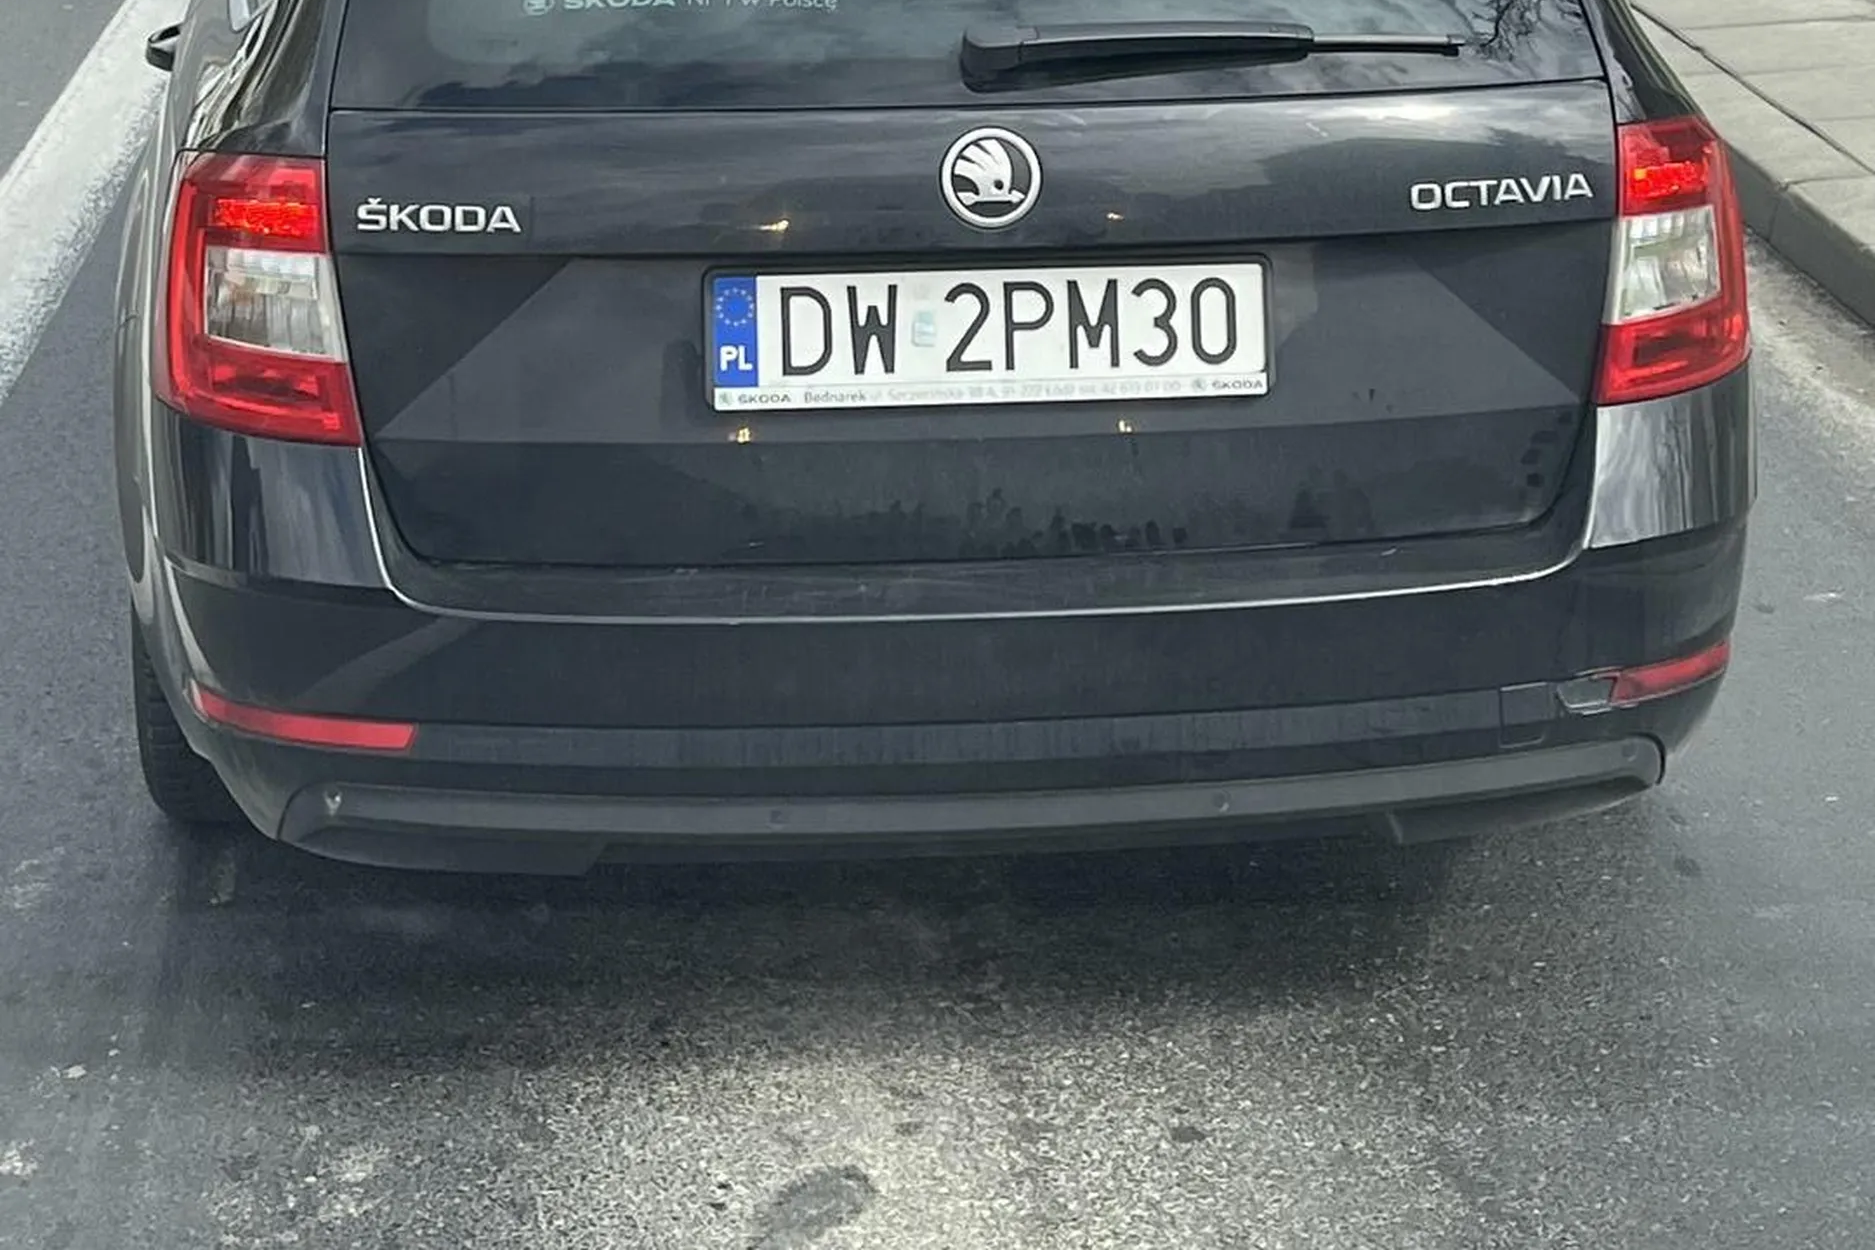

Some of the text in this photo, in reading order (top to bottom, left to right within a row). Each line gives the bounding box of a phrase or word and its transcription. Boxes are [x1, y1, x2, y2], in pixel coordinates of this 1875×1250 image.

[1410, 172, 1594, 211] OCTAVIA
[356, 197, 522, 233] ŠKODA
[780, 276, 1239, 376] DW 2PM30
[719, 344, 754, 372] PL
